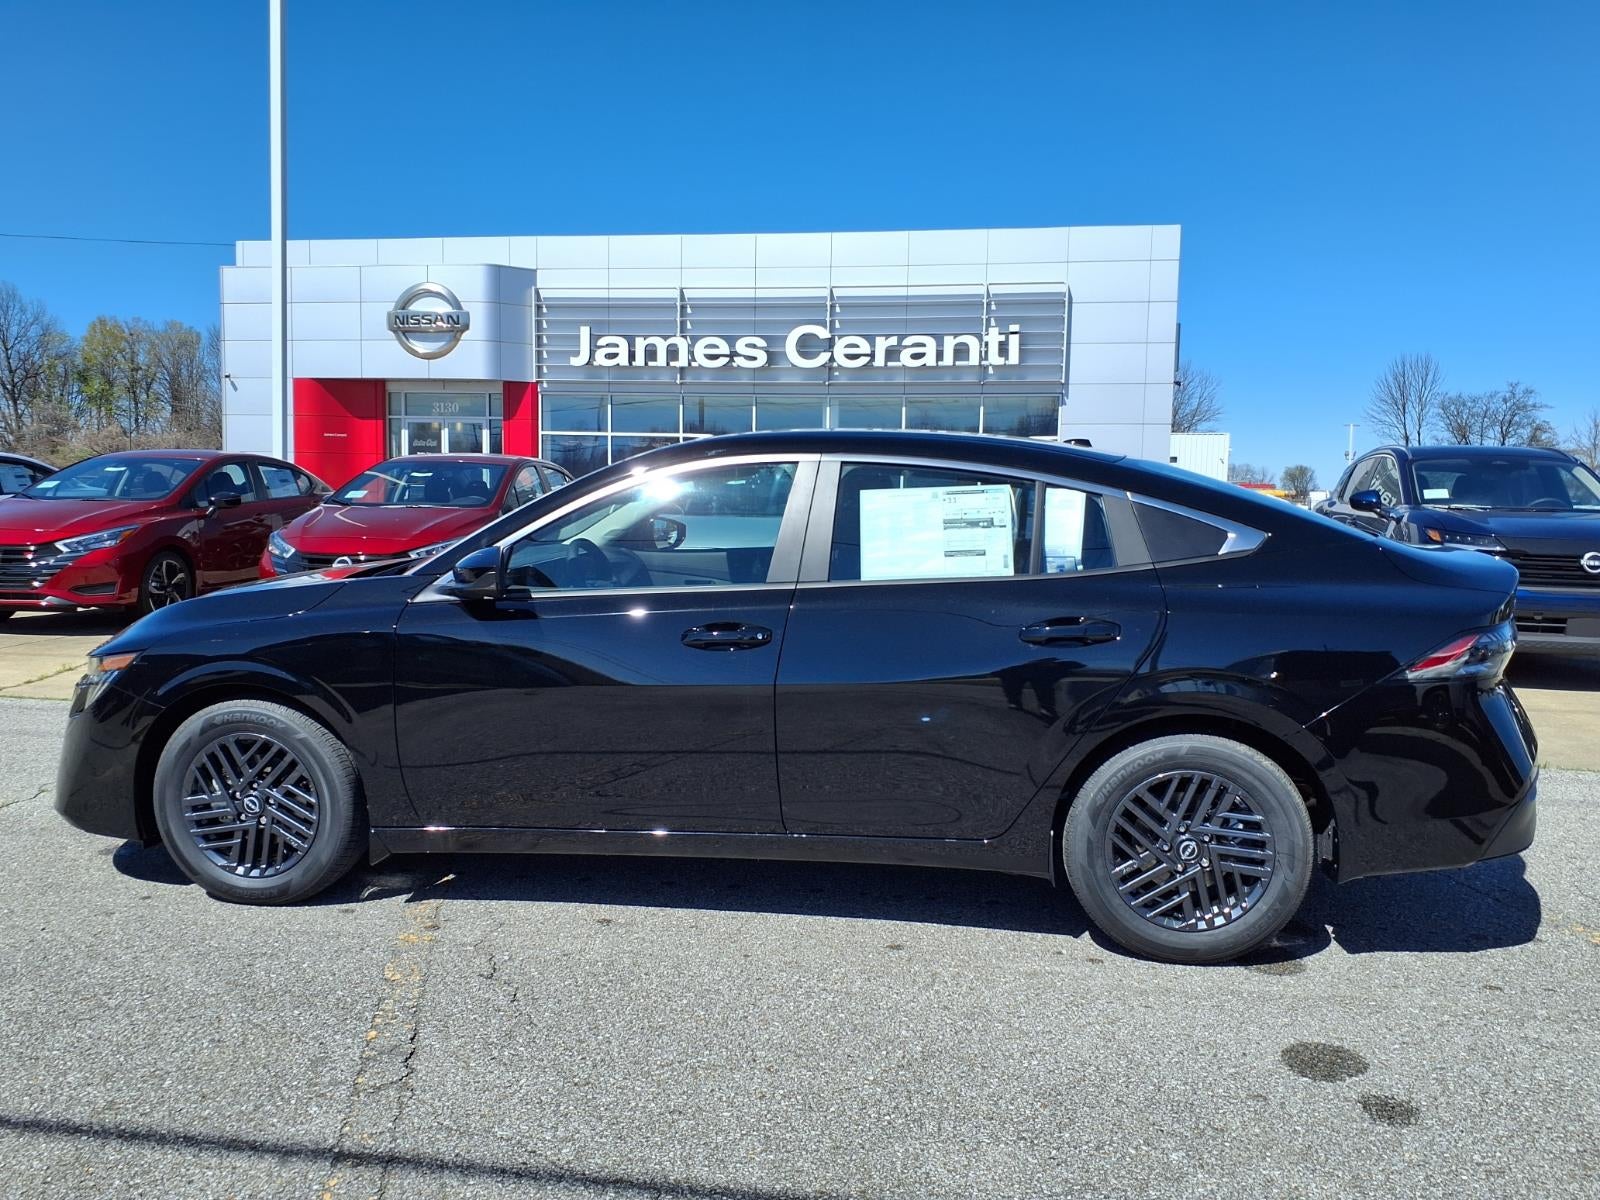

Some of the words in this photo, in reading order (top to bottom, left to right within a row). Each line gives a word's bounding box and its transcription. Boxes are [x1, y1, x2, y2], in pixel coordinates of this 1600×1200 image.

[394, 314, 460, 326] NISSAN
[569, 325, 768, 368] James
[785, 324, 1020, 368] Ceranti
[432, 402, 459, 413] 3130
